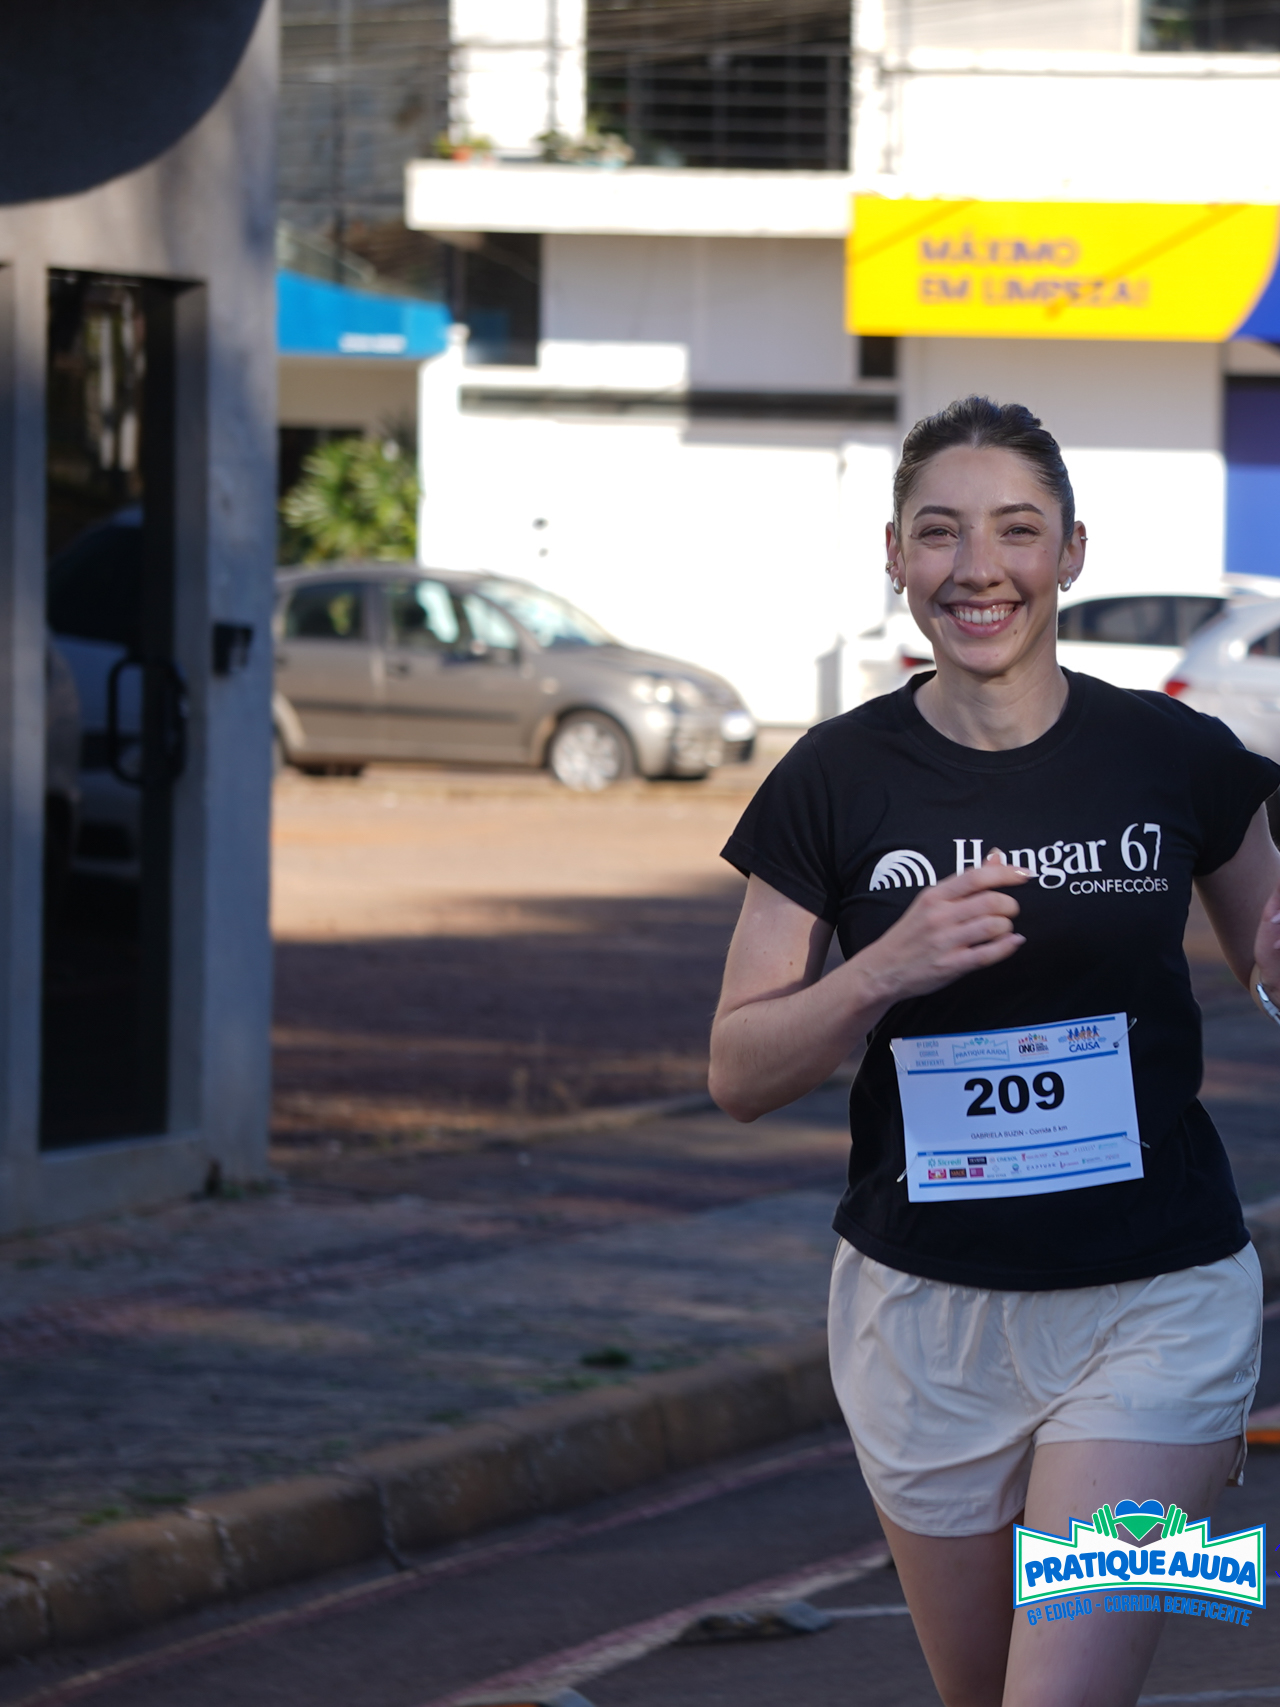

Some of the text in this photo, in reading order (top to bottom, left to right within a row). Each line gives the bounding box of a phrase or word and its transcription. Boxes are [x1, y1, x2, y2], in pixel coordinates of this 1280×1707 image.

[919, 273, 973, 304] EM
[1121, 822, 1161, 872] 67
[1069, 876, 1169, 895] CONFECÇÕES
[955, 1048, 1007, 1059] PRATIQUE AJUDA
[1069, 1041, 1100, 1053] CAUSA
[964, 1071, 1065, 1117] 209
[970, 1131, 1003, 1140] GABRIELA
[1029, 1126, 1052, 1136] Corrida
[1058, 1124, 1068, 1132] km
